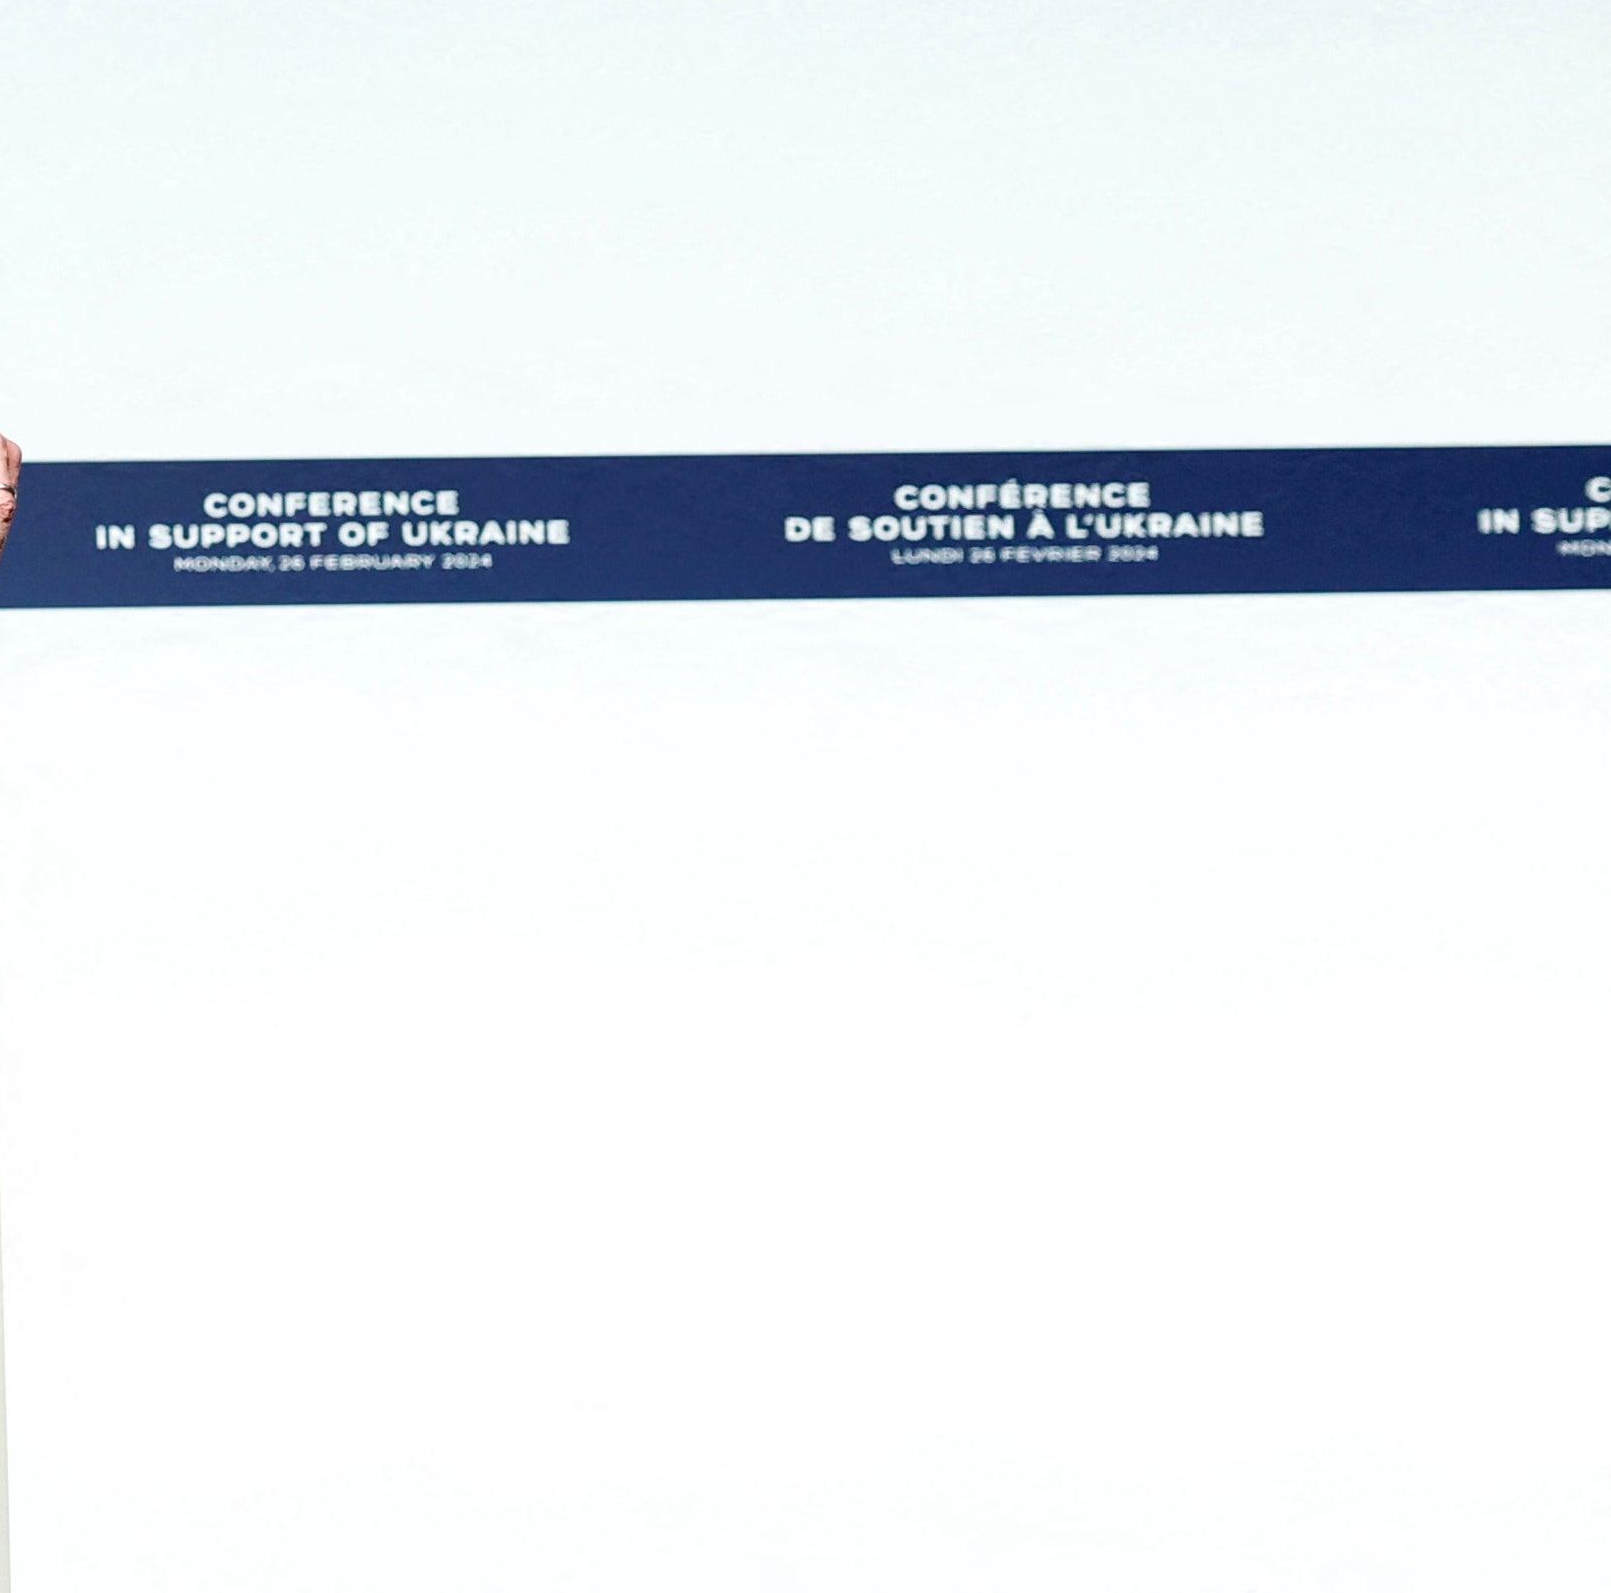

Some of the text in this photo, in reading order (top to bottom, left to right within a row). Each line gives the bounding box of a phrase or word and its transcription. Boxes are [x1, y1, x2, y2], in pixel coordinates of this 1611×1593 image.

[203, 490, 460, 519] CONFERENCE
[894, 479, 1150, 511] CONFÉRENCE
[95, 518, 570, 550] IN SUPPORT OF UKRAINE
[784, 515, 836, 542] DE
[848, 513, 1016, 542] SOUTIEN
[1026, 508, 1056, 539] À
[1476, 507, 1520, 535] IN
[278, 554, 306, 571] 26
[310, 553, 435, 571] FEBRUARY
